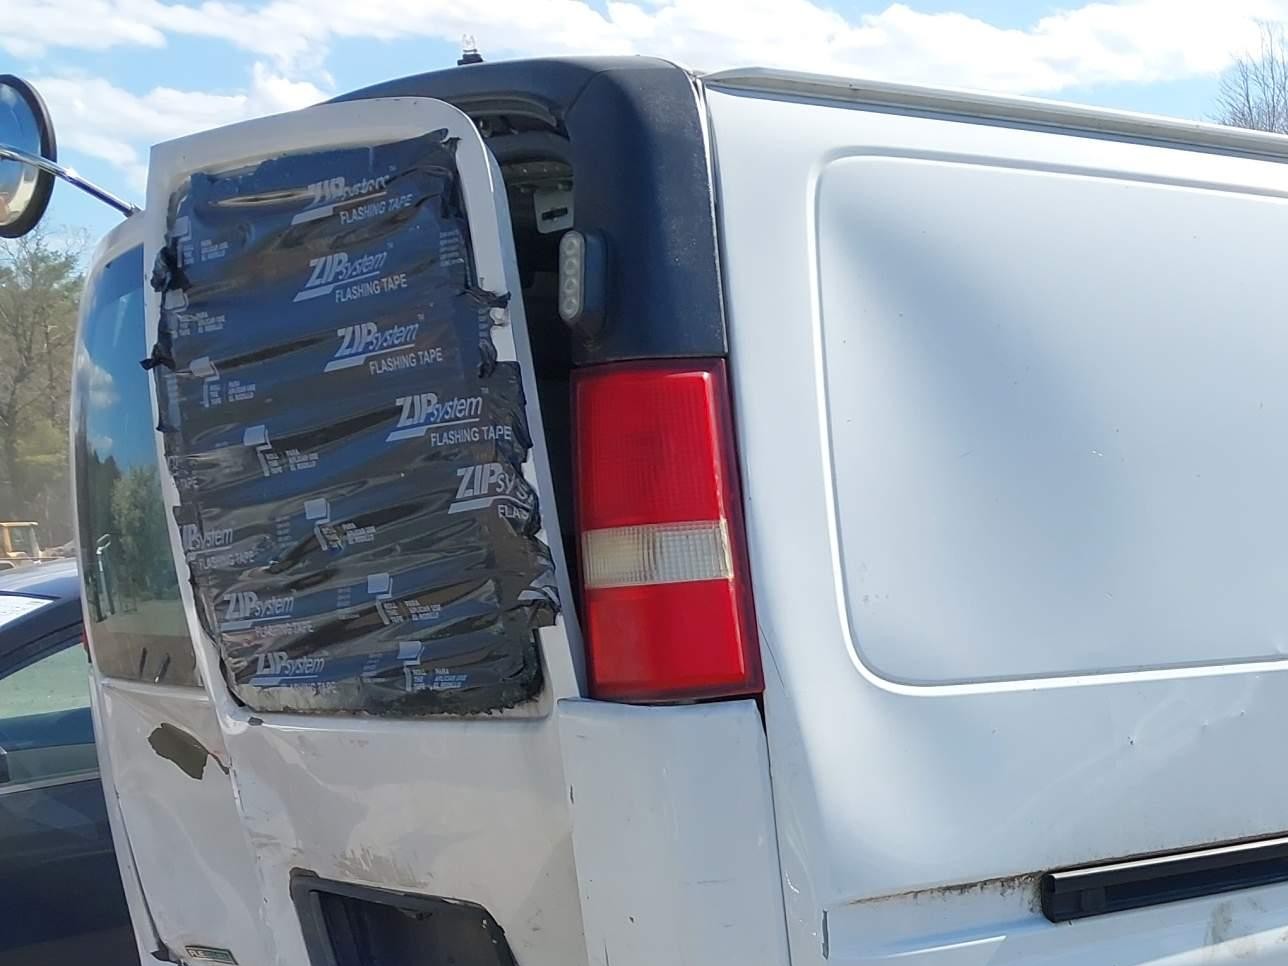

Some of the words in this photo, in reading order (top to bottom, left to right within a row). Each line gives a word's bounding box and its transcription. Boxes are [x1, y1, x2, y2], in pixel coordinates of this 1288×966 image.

[339, 200, 387, 225] FLASHING
[386, 193, 413, 213] TAPE
[335, 279, 381, 304] FLASHING
[380, 273, 408, 293] TAPE
[369, 353, 417, 375] FLASHING
[417, 347, 443, 365] TAPE
[430, 427, 480, 447] FLASHING
[480, 425, 513, 441] TAPE
